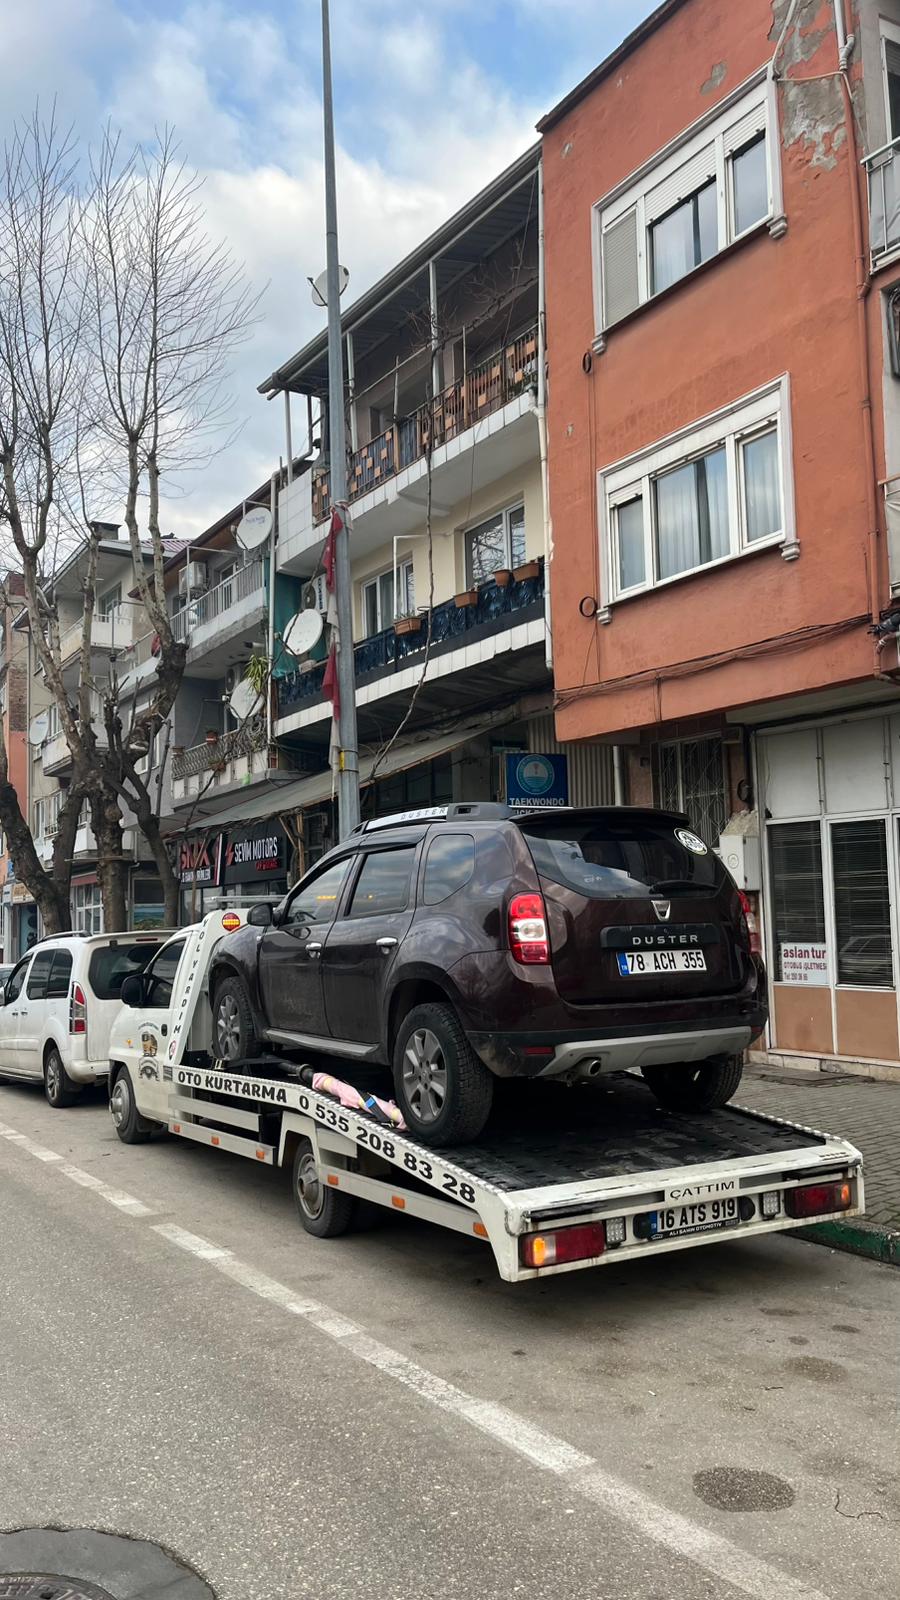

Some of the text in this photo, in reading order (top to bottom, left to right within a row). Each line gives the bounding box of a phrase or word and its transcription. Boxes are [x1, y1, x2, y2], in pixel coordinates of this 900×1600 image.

[509, 797, 565, 806] TAEKWONDO
[401, 808, 446, 820] DUSTER
[234, 836, 278, 862] SEVİM MOTORS
[632, 934, 699, 945] DUSTER
[627, 951, 705, 972] 78 ACH 355
[783, 945, 826, 959] aslan tur
[173, 918, 208, 1034] YOL YARDIM
[178, 1071, 476, 1204] OTO KURTARMA 0 535 208 83 28
[669, 1181, 735, 1200] ÇATTIM
[660, 1198, 736, 1230] 16 ATS 919
